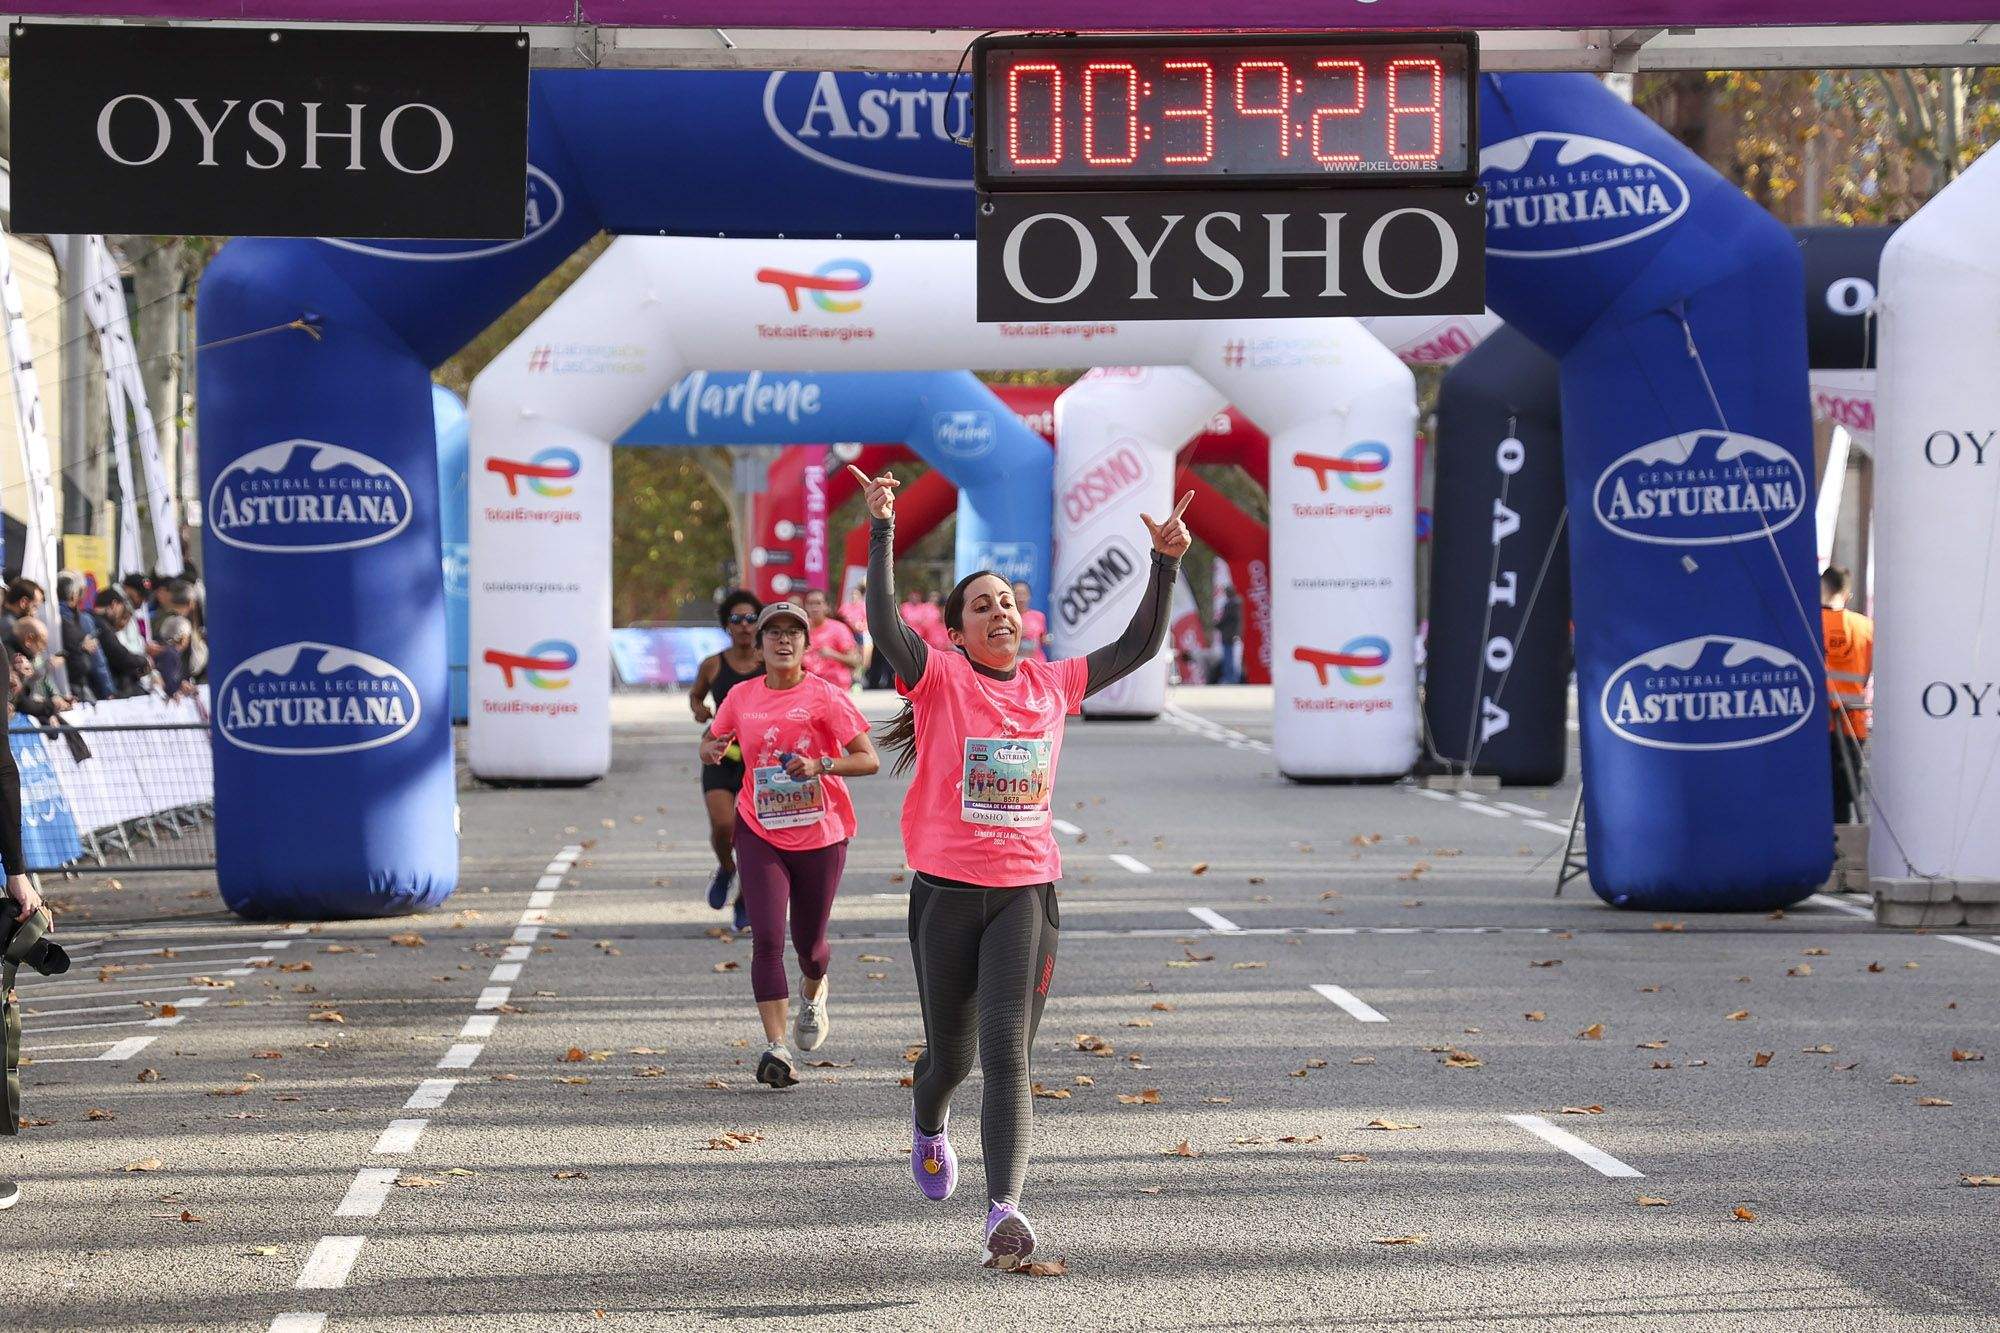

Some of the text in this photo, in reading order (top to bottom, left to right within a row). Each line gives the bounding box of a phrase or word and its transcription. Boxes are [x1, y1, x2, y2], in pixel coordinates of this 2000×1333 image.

[797, 71, 973, 140] ASTU
[97, 94, 454, 174] OYSHO
[1323, 159, 1438, 172] WWW.PIXELCOM.ES
[1484, 167, 1657, 193] ENTRAL LECHERA
[1003, 207, 1459, 304] OYSHO
[652, 369, 822, 437] Marlene
[240, 477, 393, 492] CENTRAL LECHERA
[1064, 448, 1141, 524] COSMO
[1607, 476, 1797, 521] ASTURIANA
[1638, 467, 1716, 485] CENTRAL
[218, 485, 400, 530] ASTURIANA
[1061, 547, 1132, 627] COSMO
[1481, 437, 1526, 744] VOLVO
[248, 678, 401, 694] CENTRAL LECHERA
[1645, 670, 1799, 689] CENTRAL LECHERA
[1923, 681, 2000, 719] OY
[226, 686, 408, 731] ASTURIANA
[1614, 680, 1806, 725] ASTURIANA
[996, 778, 1029, 792] 016
[972, 811, 1003, 821] OYSHO
